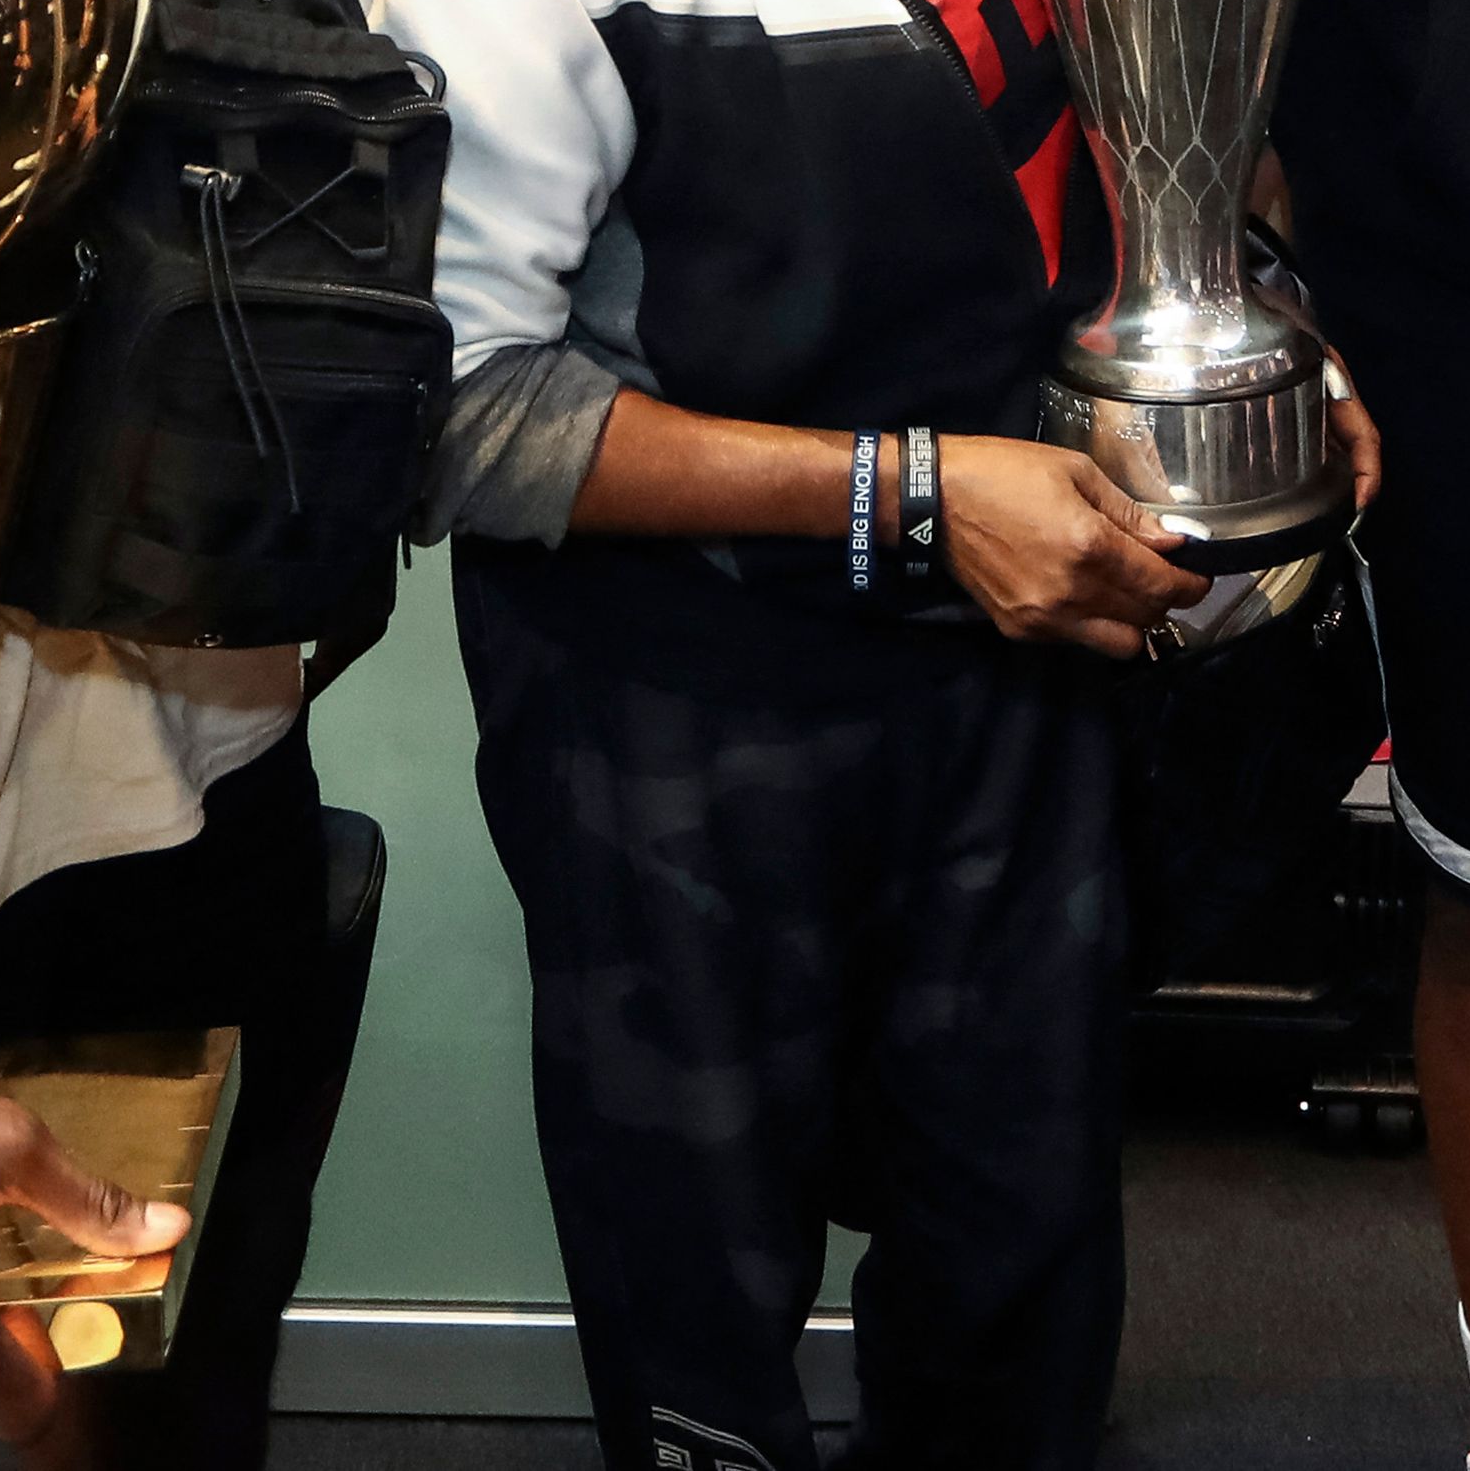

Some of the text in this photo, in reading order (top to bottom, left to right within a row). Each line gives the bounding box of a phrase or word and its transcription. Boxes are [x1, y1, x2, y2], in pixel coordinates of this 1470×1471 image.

[853, 436, 875, 514] ENOUGH
[852, 518, 869, 551] BIG
[852, 554, 869, 571] IS
